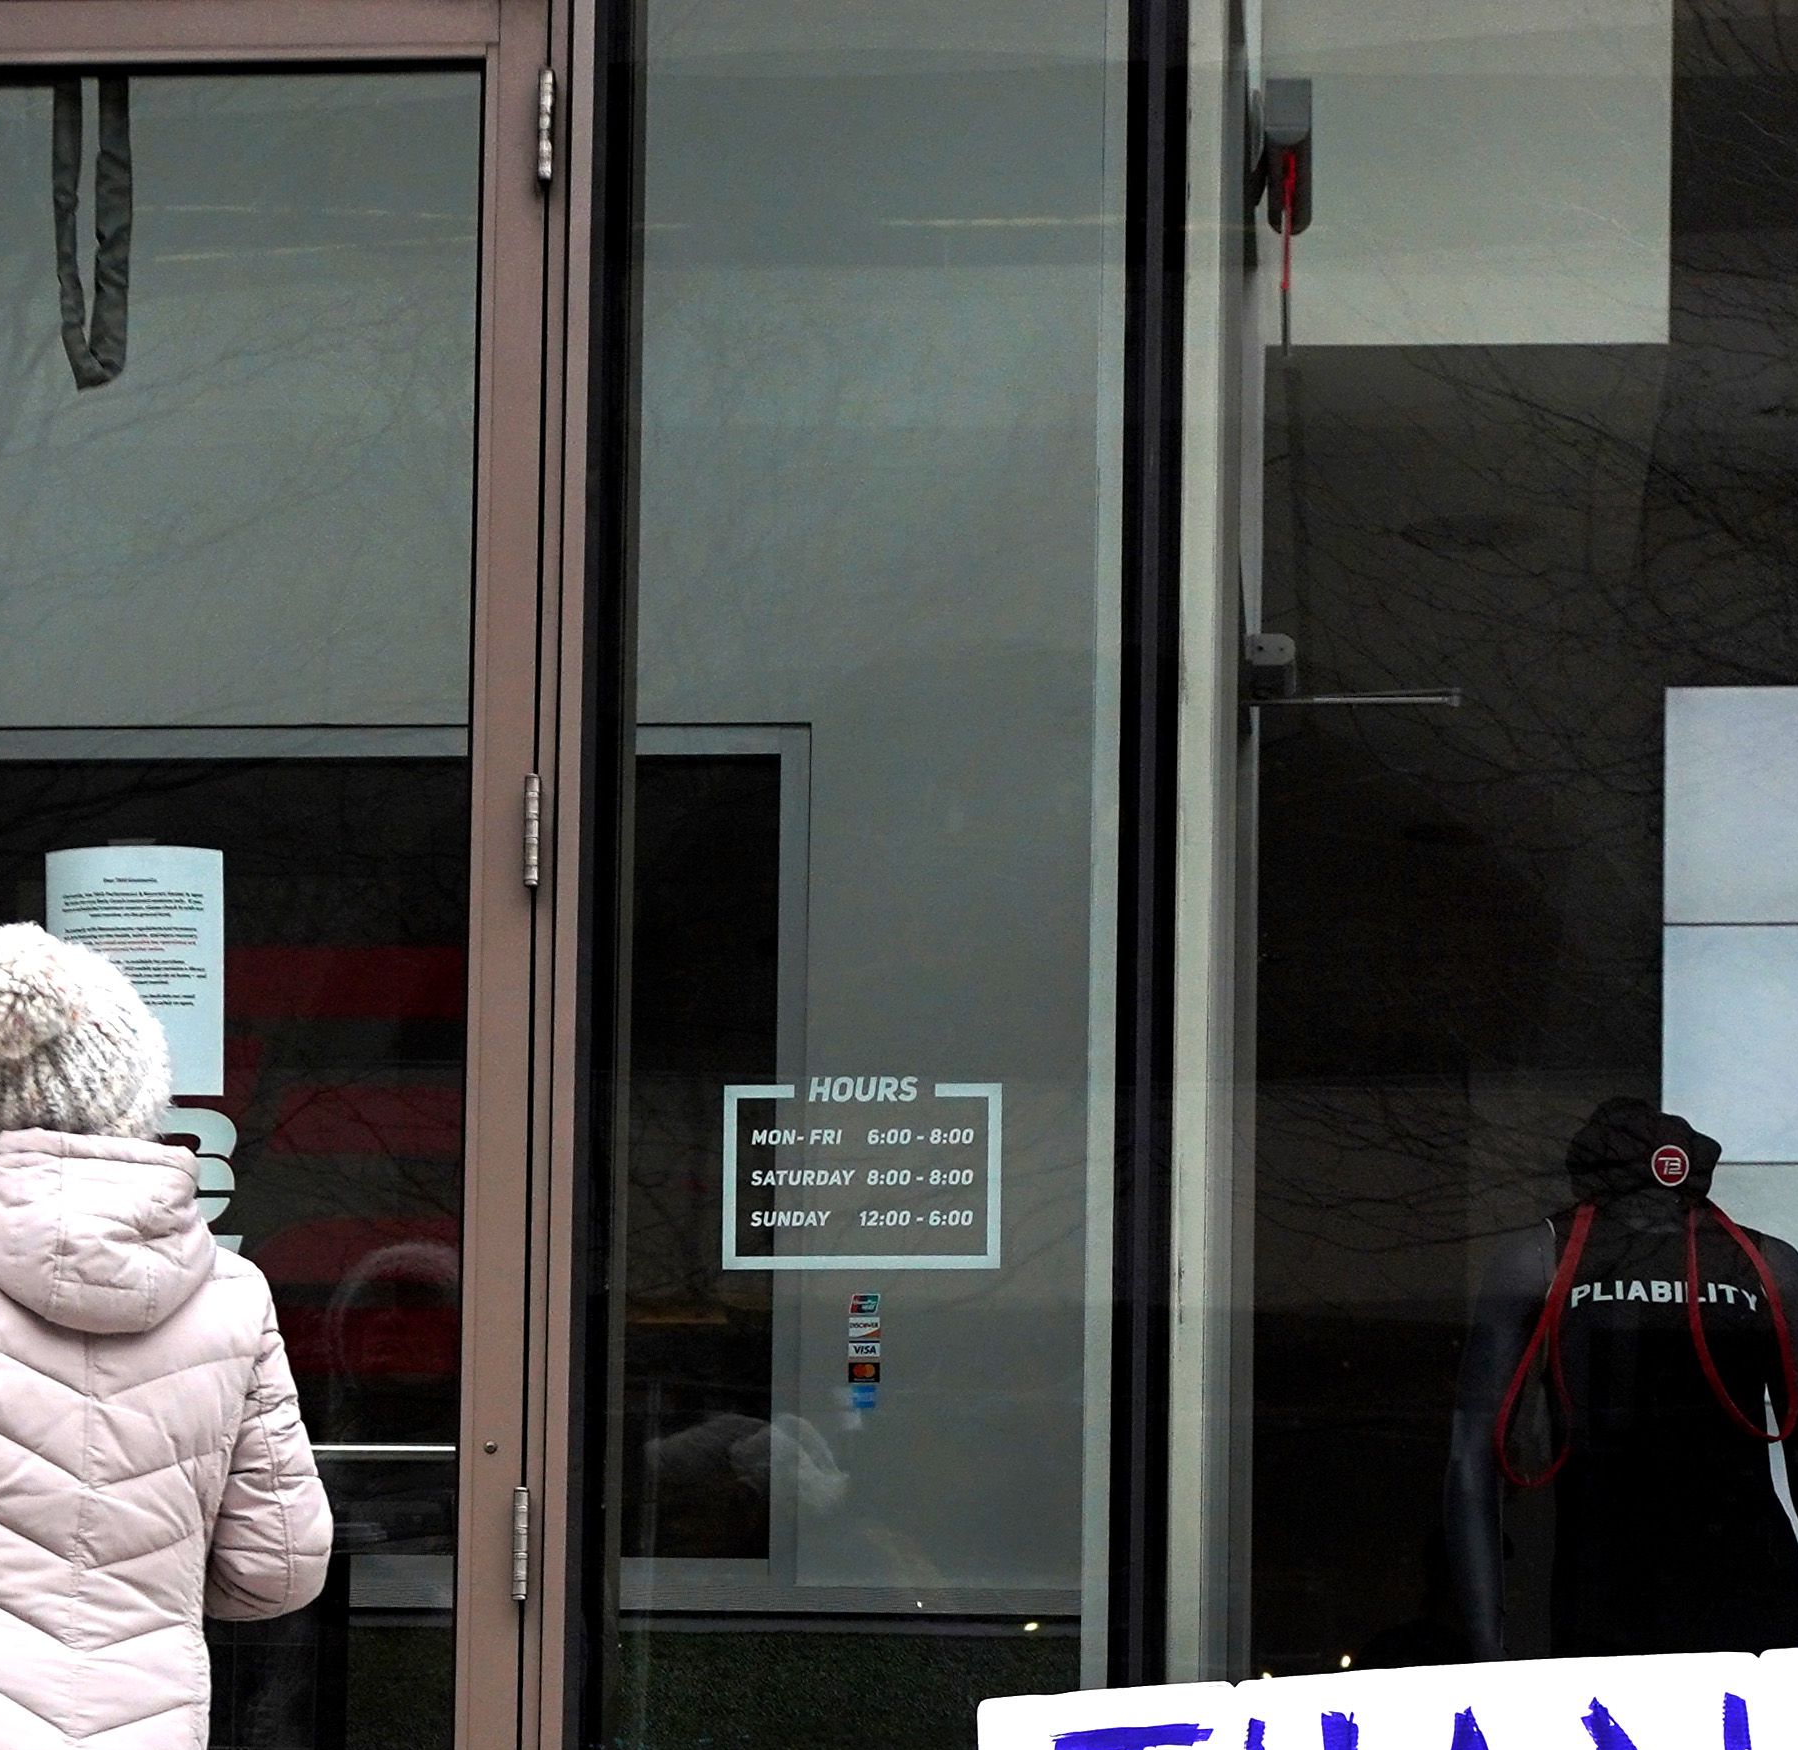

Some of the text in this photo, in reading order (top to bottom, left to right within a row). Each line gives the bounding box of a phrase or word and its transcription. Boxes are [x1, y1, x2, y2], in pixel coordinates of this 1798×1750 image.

[807, 1076, 919, 1103] HOURS
[809, 1129, 843, 1145] FRI
[867, 1128, 912, 1145] 6:00
[929, 1128, 974, 1145] 8:00
[750, 1169, 855, 1186] SATURDAY
[867, 1169, 912, 1186] 8:00
[929, 1169, 974, 1186] 8:00
[750, 1210, 831, 1227] SUNDAY
[859, 1210, 911, 1227] 12:00
[928, 1210, 974, 1227] 6:00
[853, 1345, 877, 1355] VISA
